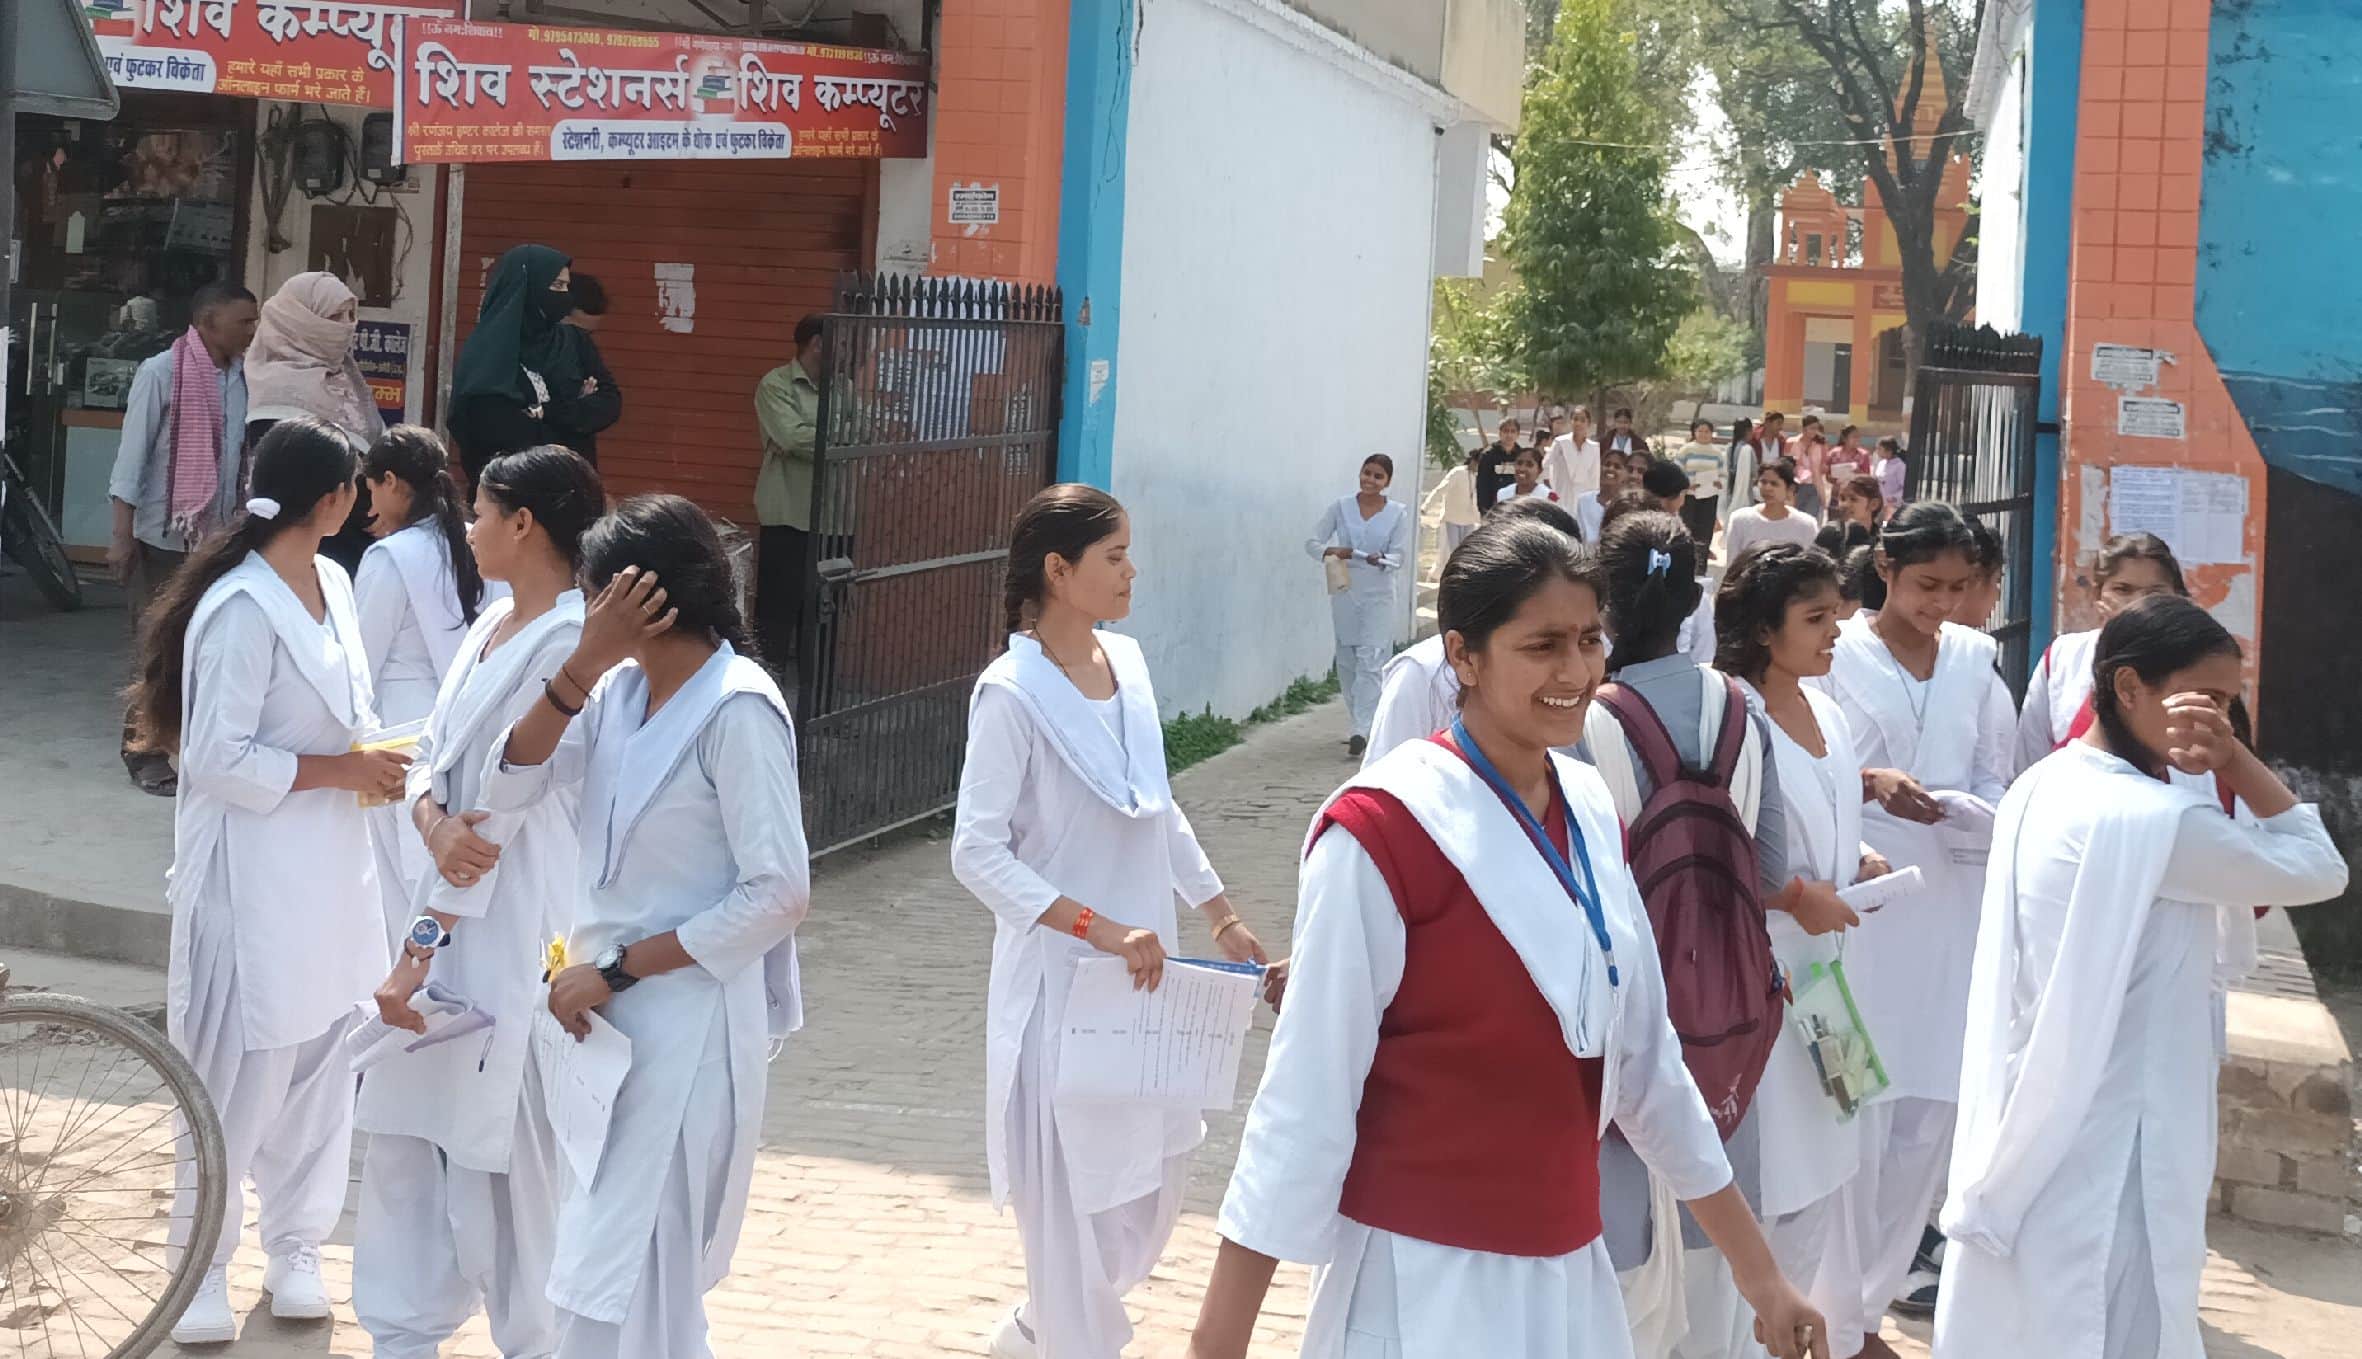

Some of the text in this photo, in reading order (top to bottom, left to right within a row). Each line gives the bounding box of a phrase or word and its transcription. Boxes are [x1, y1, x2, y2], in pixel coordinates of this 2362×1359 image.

[126, 59, 163, 82] फुटकर
[227, 58, 256, 75] हमारे
[315, 67, 347, 81] प्रकार
[415, 42, 689, 109] शिव स्टेशनर्स
[738, 53, 925, 132] शिव कम्प्यूटर
